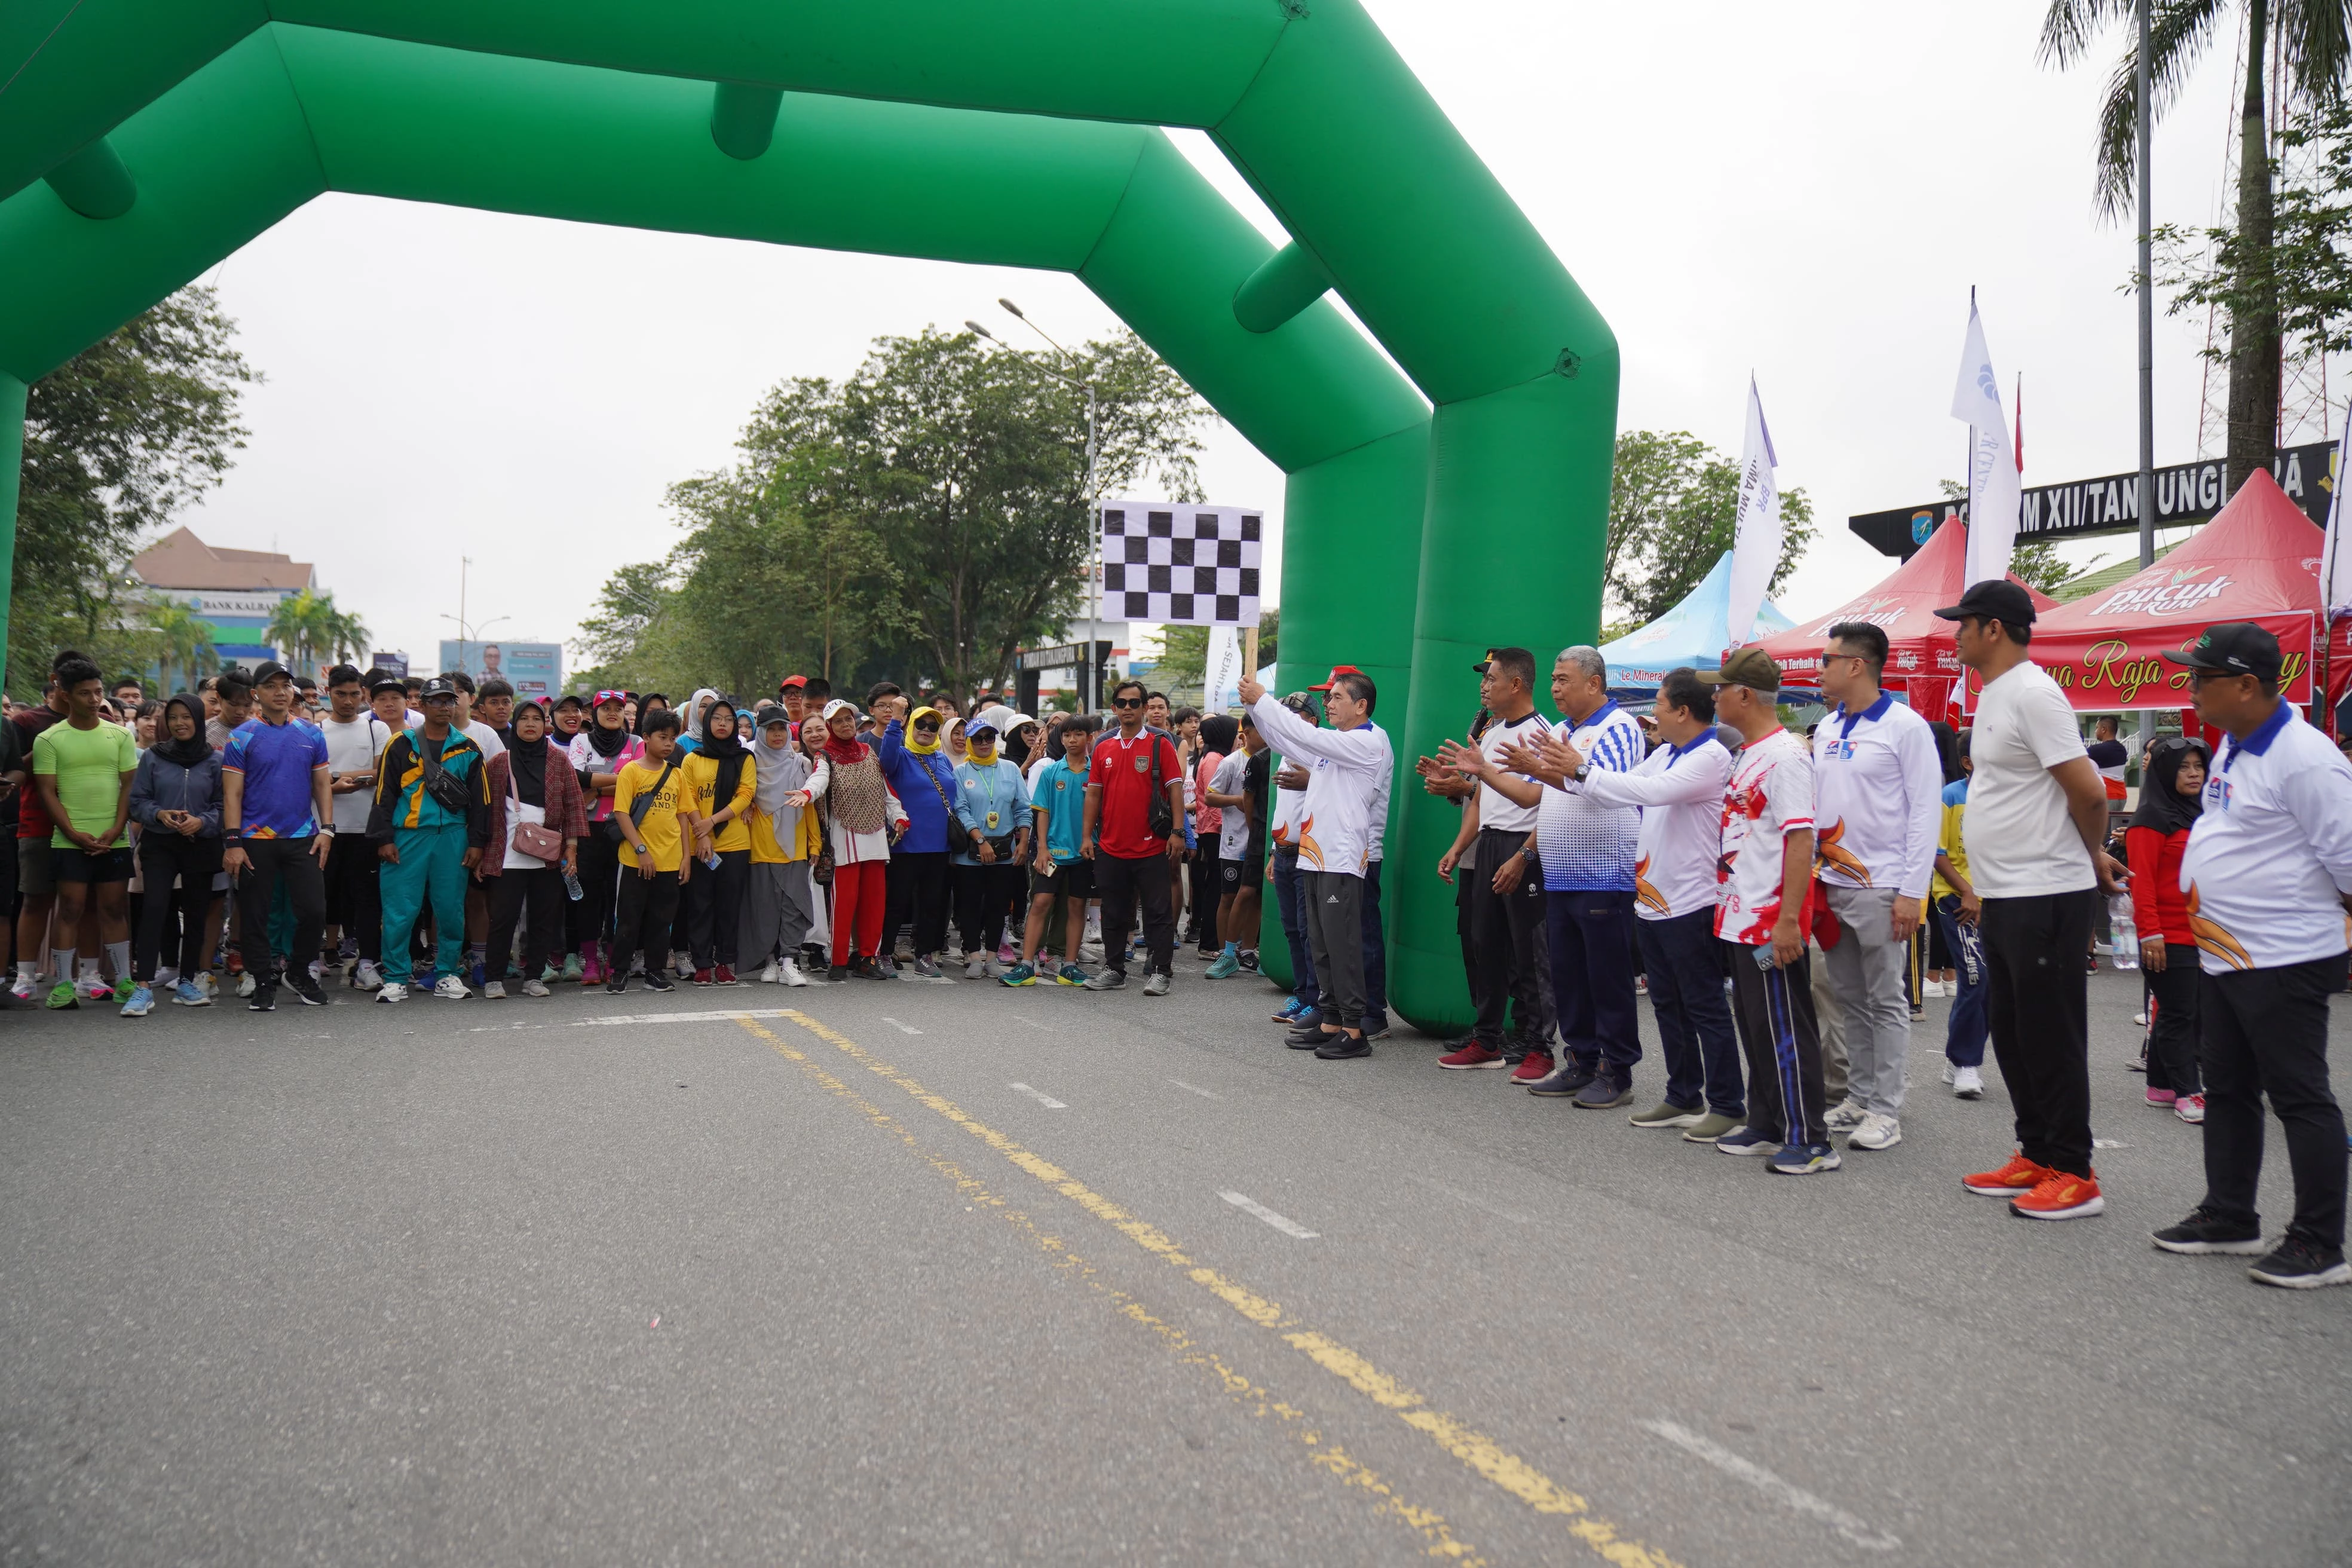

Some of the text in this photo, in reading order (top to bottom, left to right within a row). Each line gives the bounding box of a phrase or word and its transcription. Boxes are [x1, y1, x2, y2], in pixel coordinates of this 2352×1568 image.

[1756, 483, 1770, 513] BPR
[2046, 453, 2304, 530] XII/TANUNGA
[203, 601, 232, 610] BANK
[1788, 657, 1814, 669] Terbaik
[2081, 638, 2165, 704] Raja
[1621, 669, 1630, 681] Le
